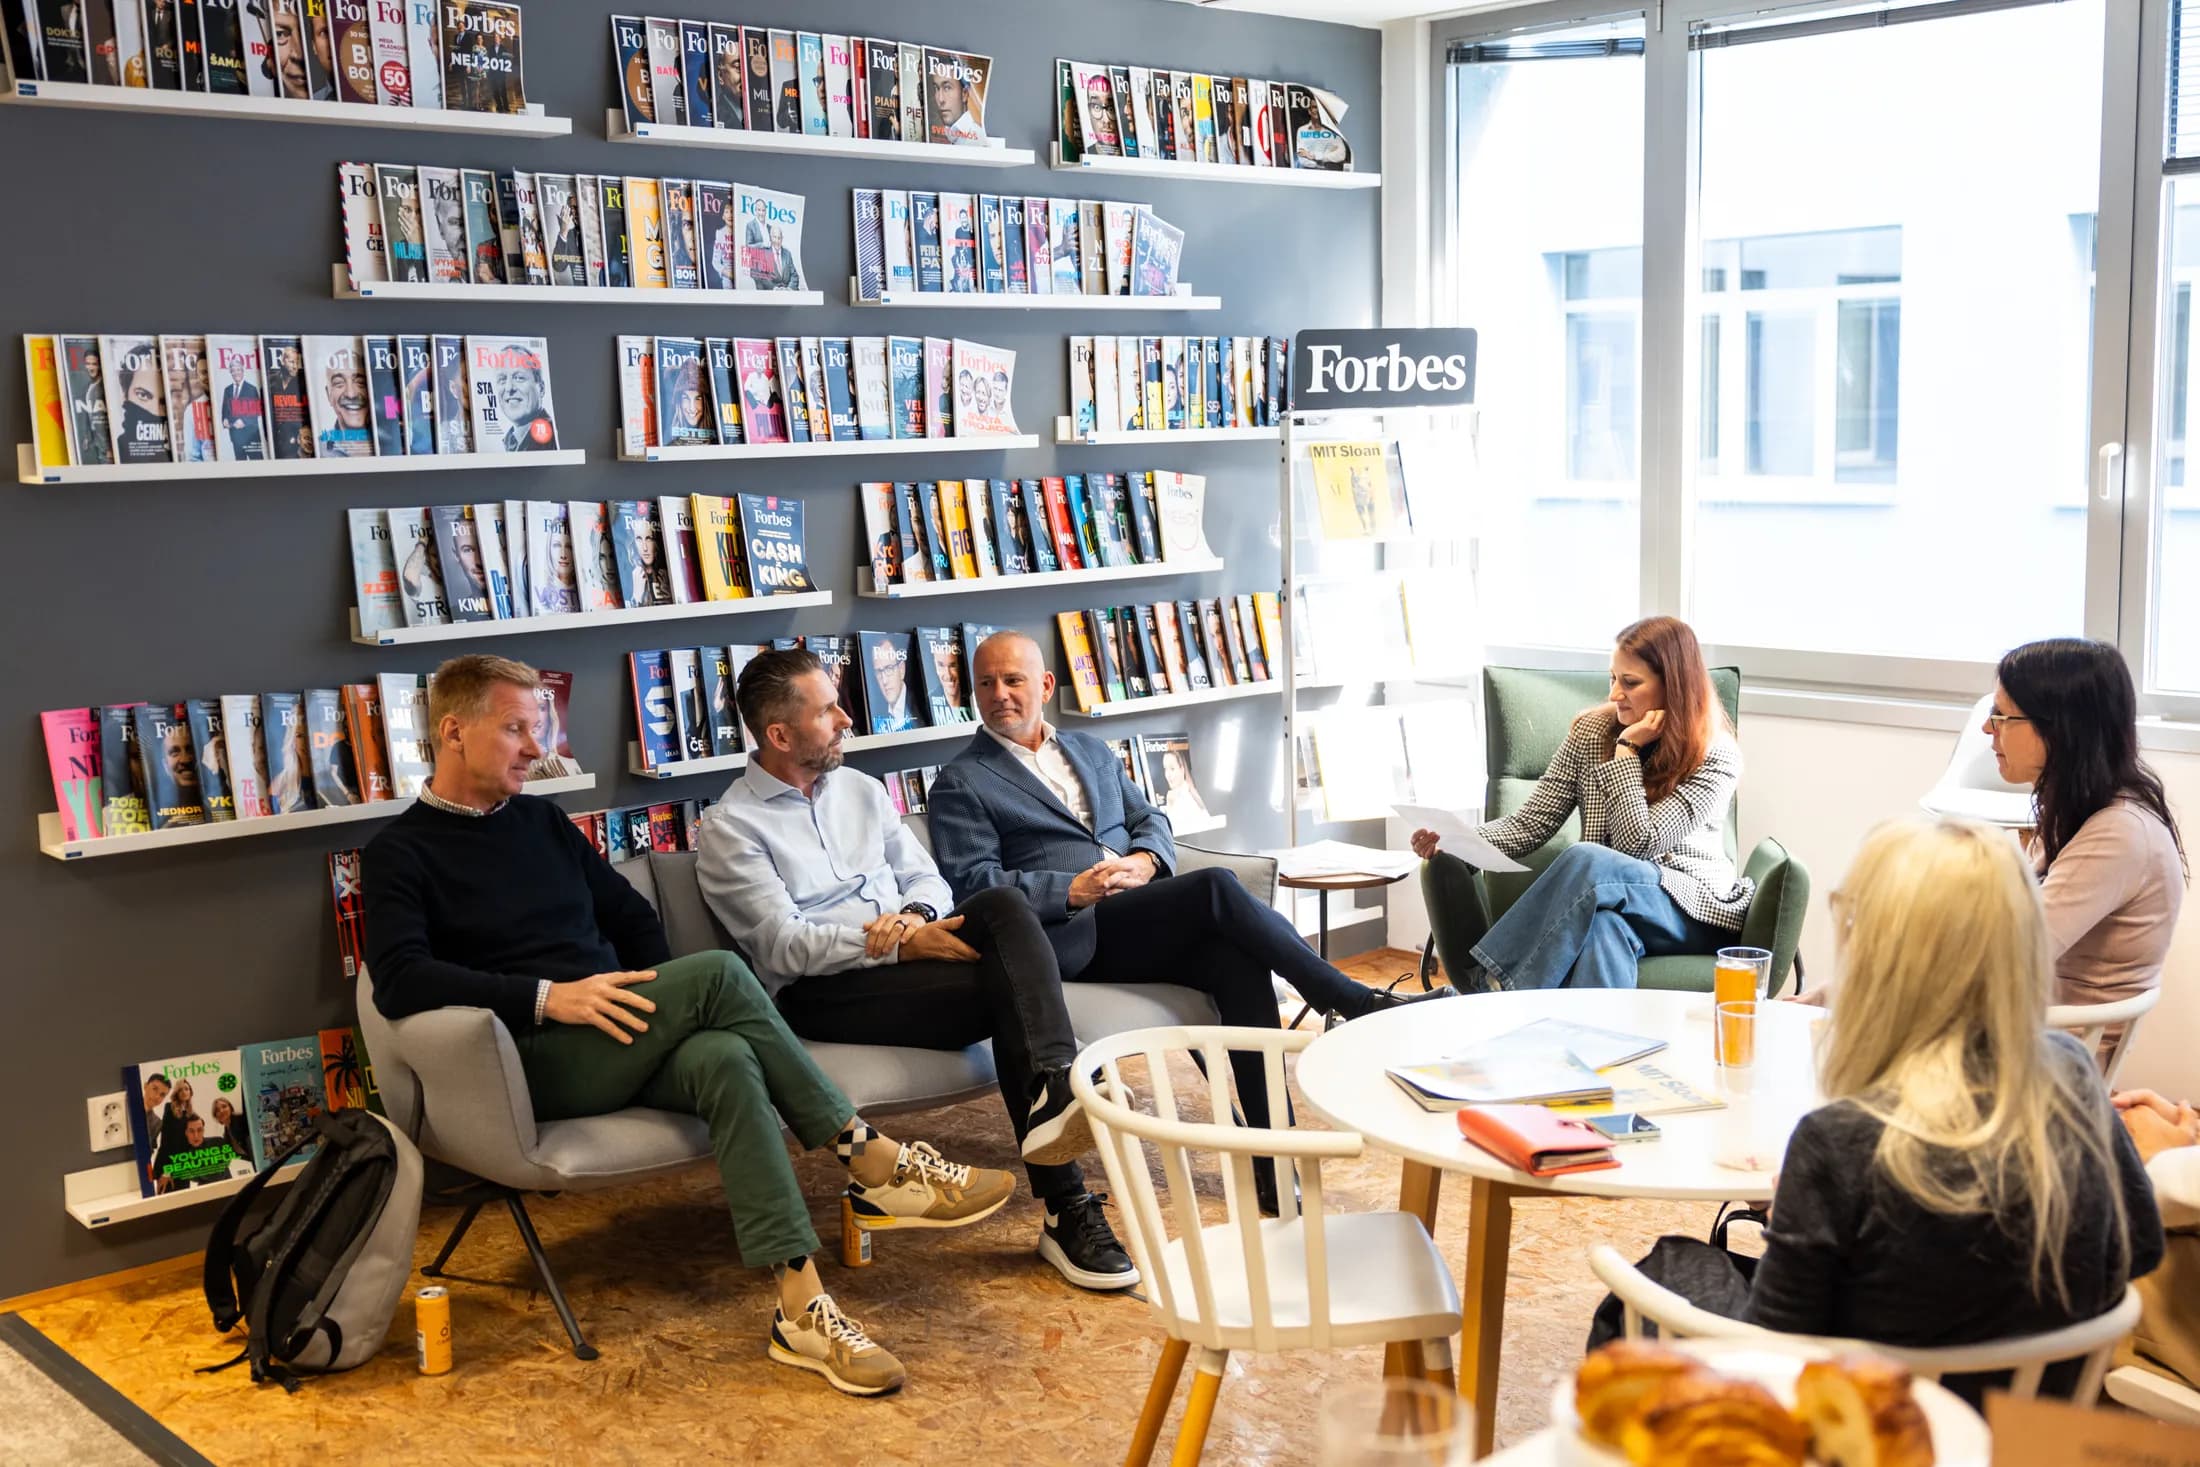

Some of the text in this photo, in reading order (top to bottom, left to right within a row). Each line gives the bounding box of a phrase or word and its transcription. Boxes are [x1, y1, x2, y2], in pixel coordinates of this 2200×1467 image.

[447, 7, 516, 38] Forbes
[451, 52, 513, 73] NEJ 2012
[928, 55, 983, 84] Forbes
[741, 194, 796, 224] Fobes
[1142, 217, 1178, 253] Forbes
[476, 346, 541, 370] Forbes
[960, 351, 1008, 374] Forbes
[1306, 344, 1466, 393] Forbes
[477, 382, 493, 395] STA
[488, 395, 497, 408] VI
[482, 408, 498, 421] TEL
[1313, 445, 1380, 458] MIT Sloan
[754, 509, 792, 528] Forbes
[752, 539, 802, 564] CASH
[758, 564, 807, 588] KING
[873, 645, 908, 661] Forbes
[929, 640, 961, 654] Forbes
[818, 650, 851, 665] Forbes
[260, 1046, 314, 1065] Forbes
[163, 1061, 221, 1081] Forbes
[163, 1152, 242, 1174] BEAUTIFUL
[169, 1144, 232, 1163] YOUNG &
